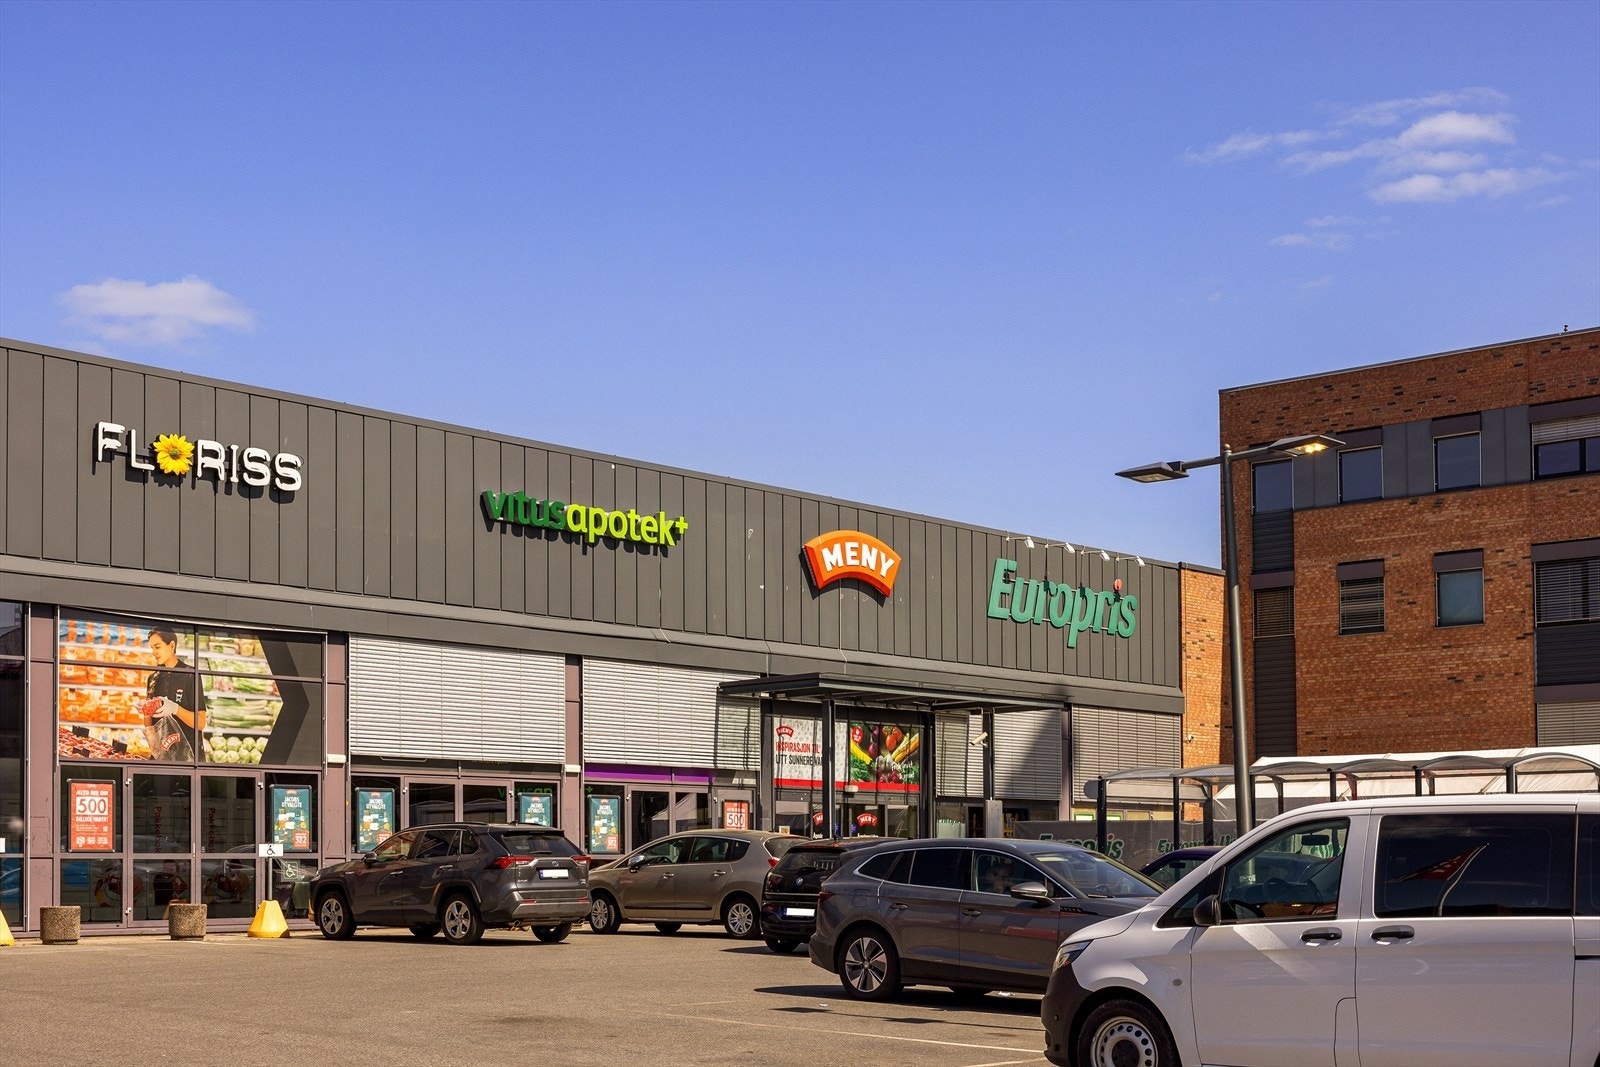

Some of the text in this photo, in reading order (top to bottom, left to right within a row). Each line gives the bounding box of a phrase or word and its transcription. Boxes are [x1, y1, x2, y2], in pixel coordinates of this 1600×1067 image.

[97, 421, 303, 492] FLORISS
[820, 541, 896, 579] MENY
[987, 557, 1138, 648] Europris
[77, 798, 107, 814] 500
[727, 814, 745, 826] 500
